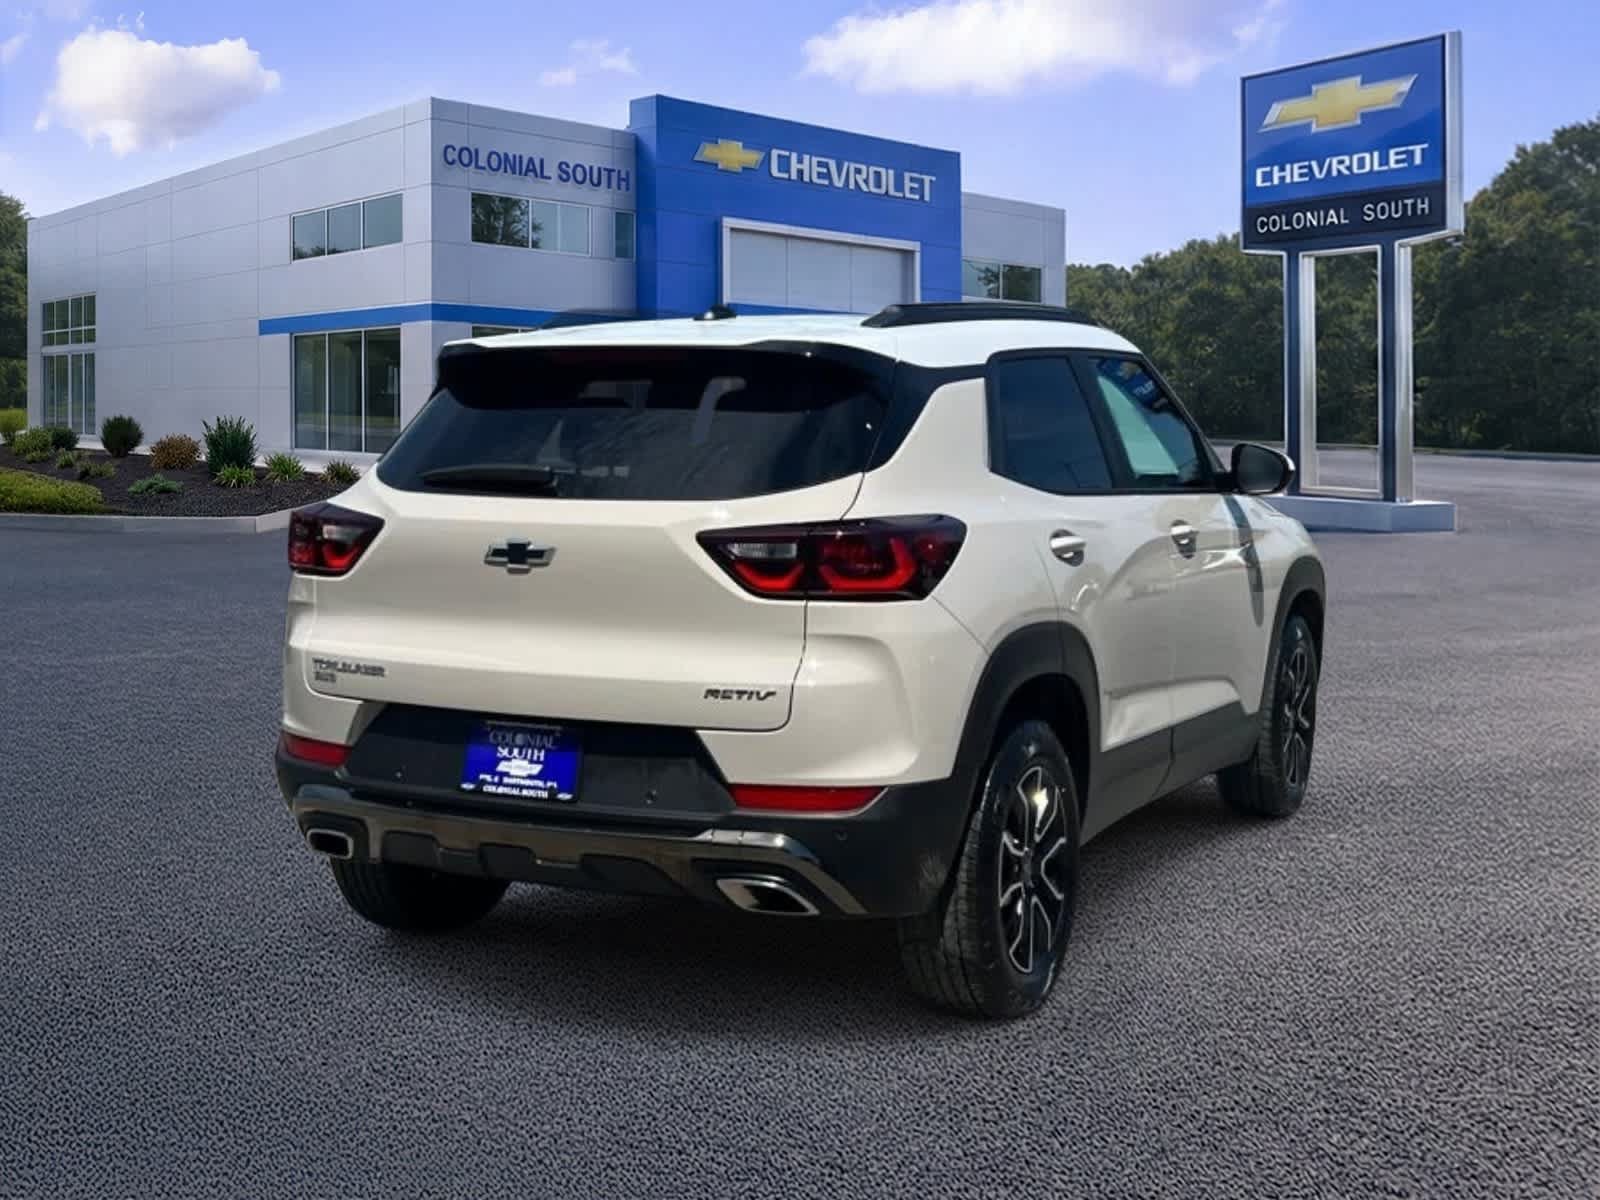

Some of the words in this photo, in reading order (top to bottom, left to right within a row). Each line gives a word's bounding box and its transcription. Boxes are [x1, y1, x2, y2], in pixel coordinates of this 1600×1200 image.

[443, 144, 552, 180] COLONIAL
[557, 161, 631, 192] SOUTH
[770, 148, 937, 202] CHEVROLET
[1255, 143, 1429, 188] CHEVROLET
[1256, 207, 1349, 233] COLONIAL
[1362, 197, 1430, 221] SOUTH
[496, 746, 545, 761] SOUTH
